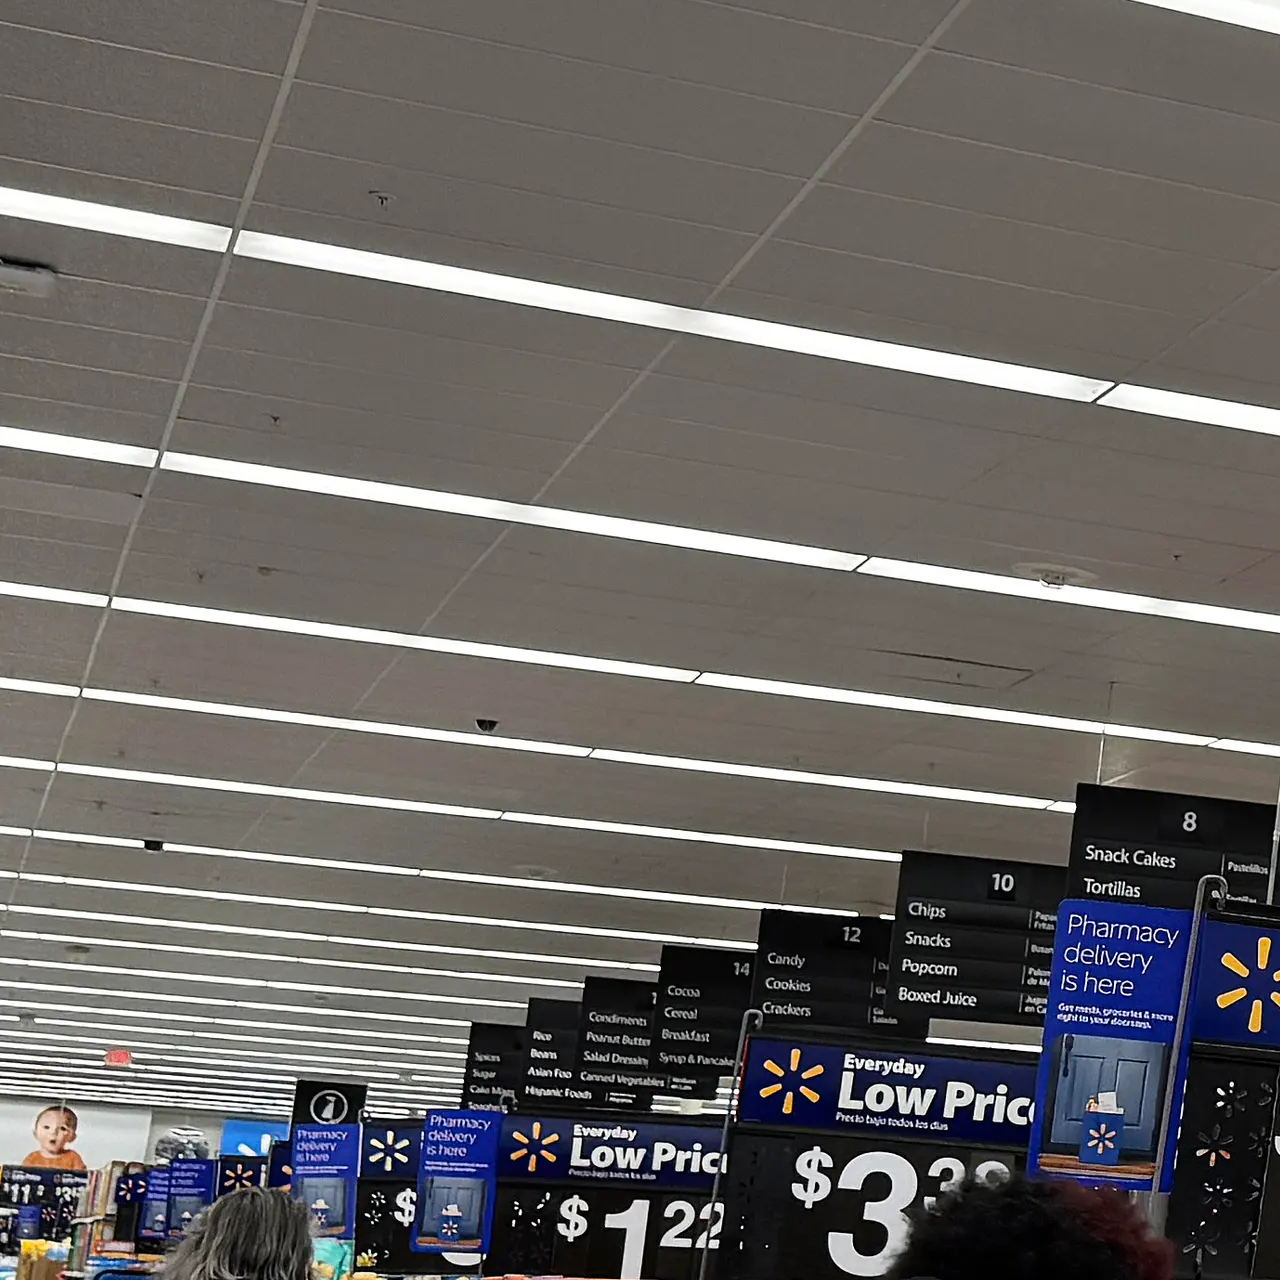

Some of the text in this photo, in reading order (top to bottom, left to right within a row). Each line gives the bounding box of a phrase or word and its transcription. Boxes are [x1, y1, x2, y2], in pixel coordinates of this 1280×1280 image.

[1182, 811, 1197, 832] 8
[1084, 844, 1177, 869] Snack Cakes
[991, 872, 1015, 892] 10
[1083, 877, 1141, 898] Tortillas
[908, 901, 947, 920] Chips
[842, 926, 861, 943] 12
[905, 931, 952, 948] Snacks
[1067, 914, 1180, 949] Pharmacy
[767, 952, 806, 969] Candy
[1063, 943, 1153, 974] delivery
[733, 961, 750, 976] 14
[902, 958, 958, 977] Popcorn
[667, 985, 700, 998] Cocoa
[765, 977, 811, 992] Cookies
[1060, 969, 1135, 997] is here
[898, 986, 977, 1007] Boxed Juice
[664, 1007, 698, 1020] Cereal
[762, 1001, 812, 1017] Crackers
[588, 1011, 648, 1027] Condiments
[586, 1031, 620, 1045] Peanut
[661, 1028, 710, 1043] Breakfast
[843, 1053, 926, 1080] Everyday
[837, 1071, 937, 1117] Low
[429, 1115, 491, 1131] Pharmacy
[428, 1129, 477, 1144] delivery
[573, 1124, 637, 1142] Everyday
[438, 1145, 467, 1157] here
[570, 1137, 647, 1171] Low
